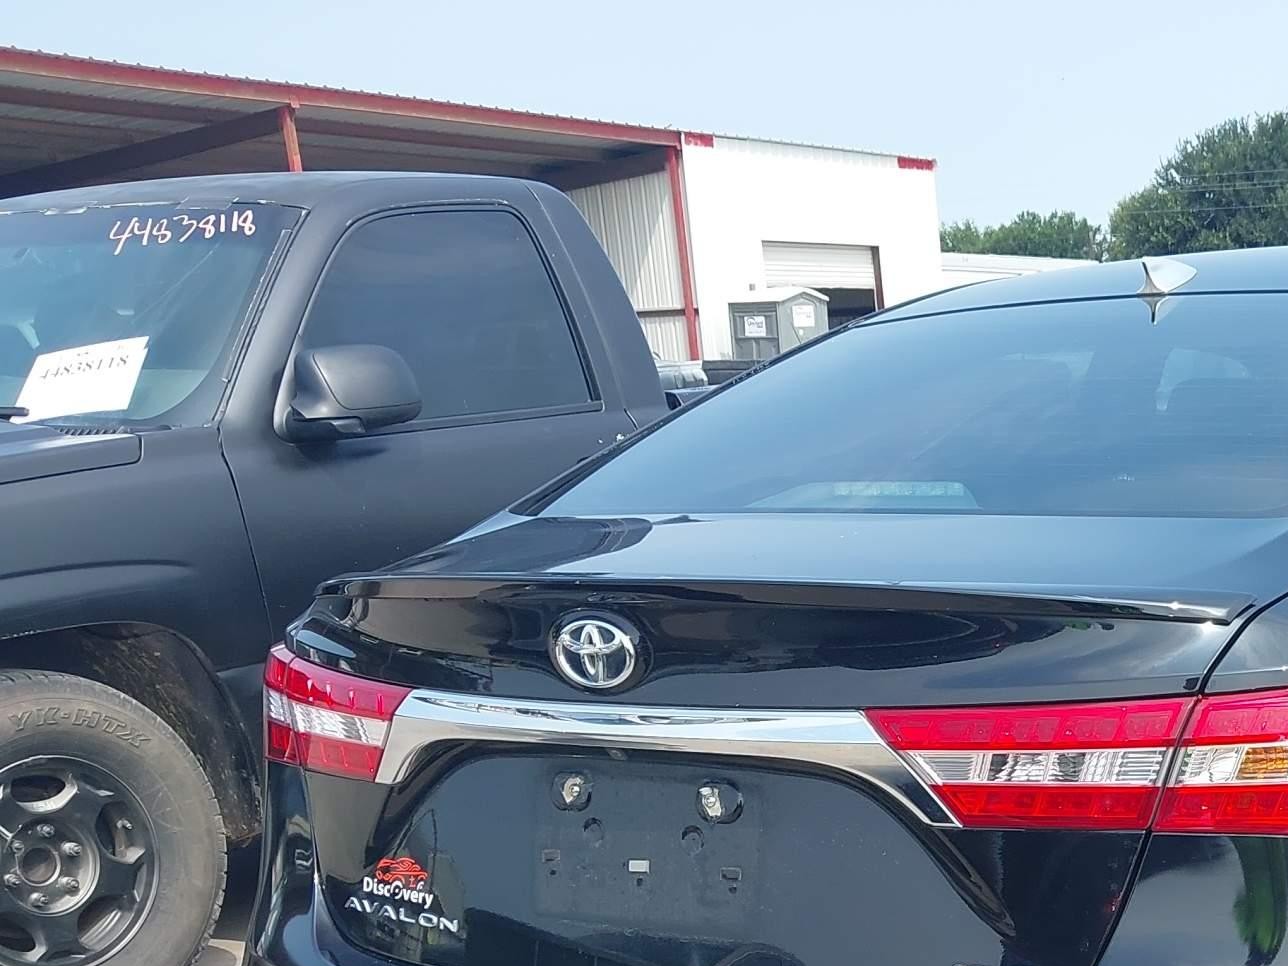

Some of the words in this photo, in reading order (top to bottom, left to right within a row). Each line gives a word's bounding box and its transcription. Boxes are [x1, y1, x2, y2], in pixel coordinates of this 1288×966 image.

[109, 210, 256, 255] 44838118
[362, 876, 434, 910] Discovery
[344, 896, 459, 933] AVALON
